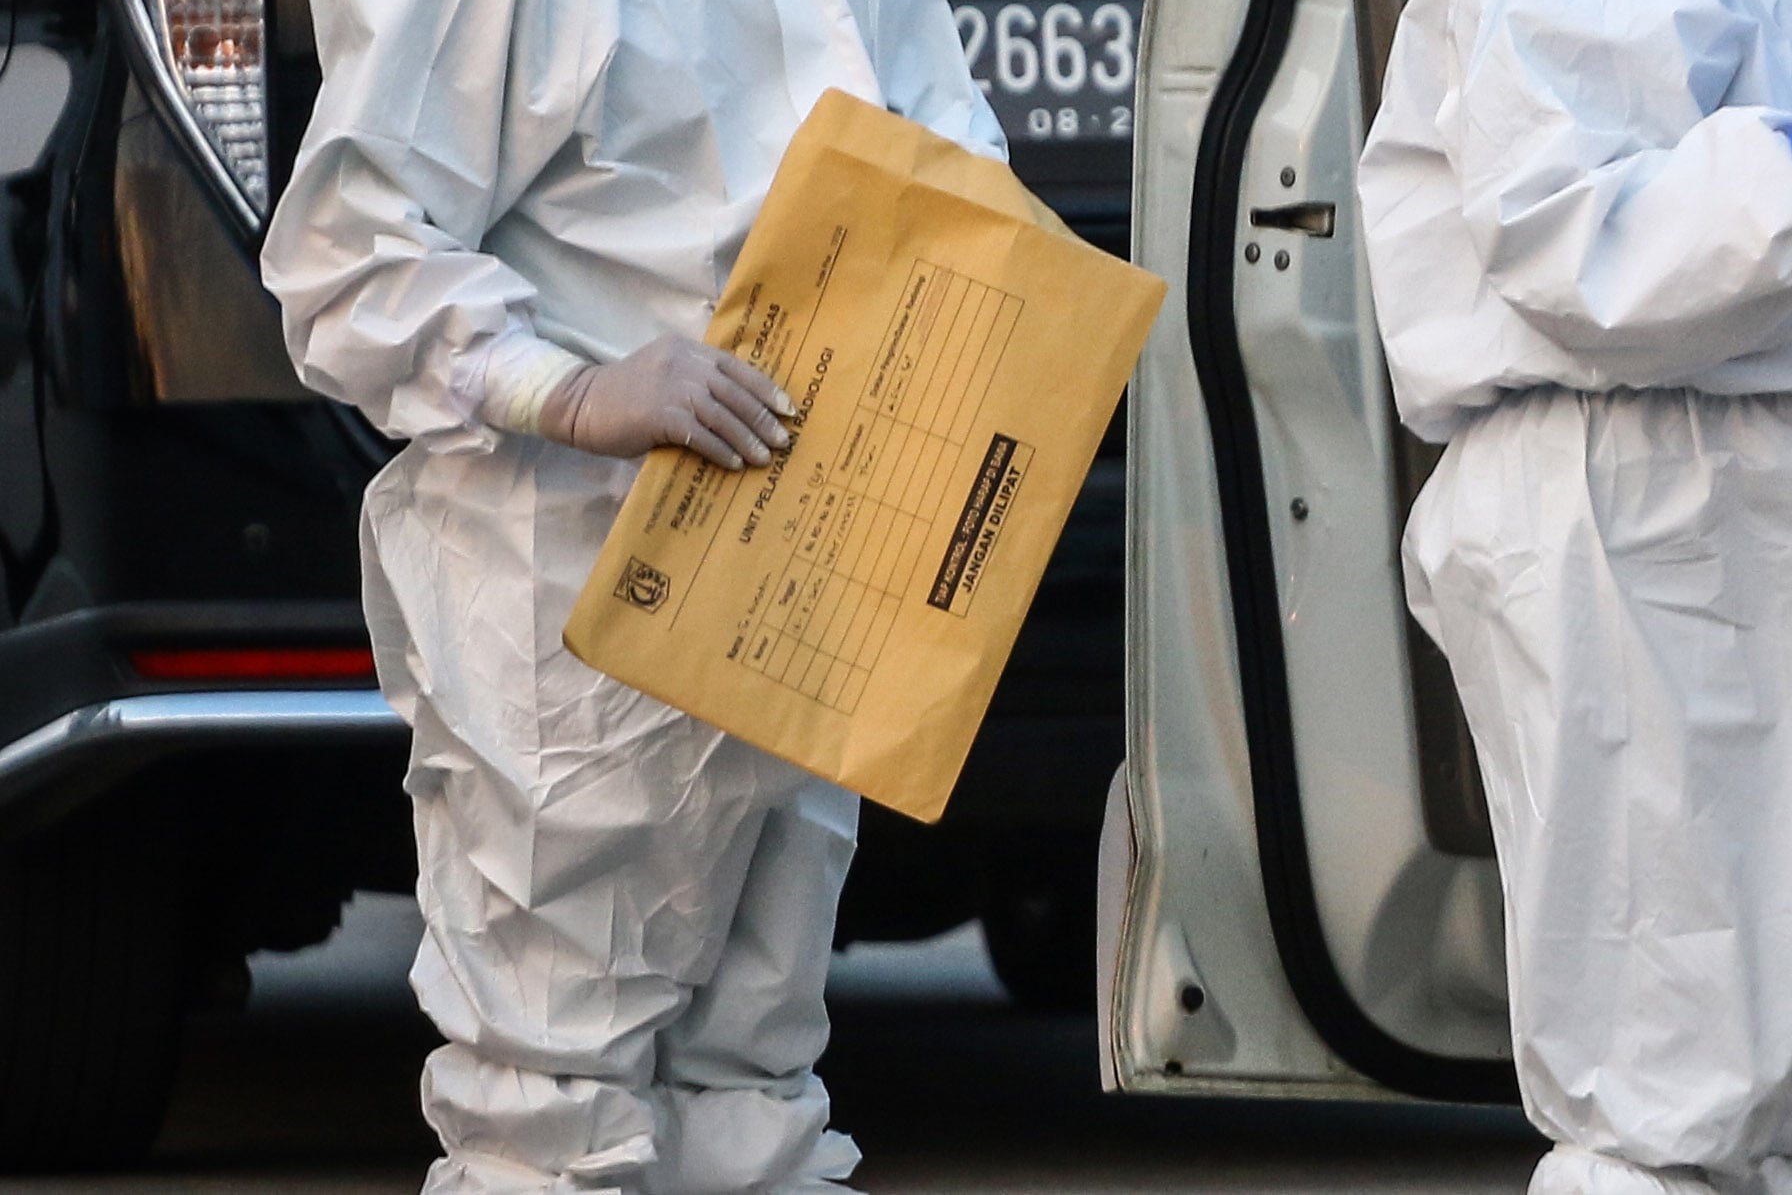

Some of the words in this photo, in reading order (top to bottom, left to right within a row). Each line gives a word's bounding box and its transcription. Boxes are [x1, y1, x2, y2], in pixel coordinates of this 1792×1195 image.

[954, 3, 1134, 94] 2663
[748, 302, 781, 360] CIRACAS
[738, 509, 762, 544] UNIT
[754, 428, 800, 511] PELAYANAN
[792, 346, 834, 428] RADIOLOGI
[669, 484, 698, 530] RUMAH
[960, 527, 996, 593] JANGAN
[988, 464, 1022, 526] DILIPAT
[961, 508, 980, 535] FOTO
